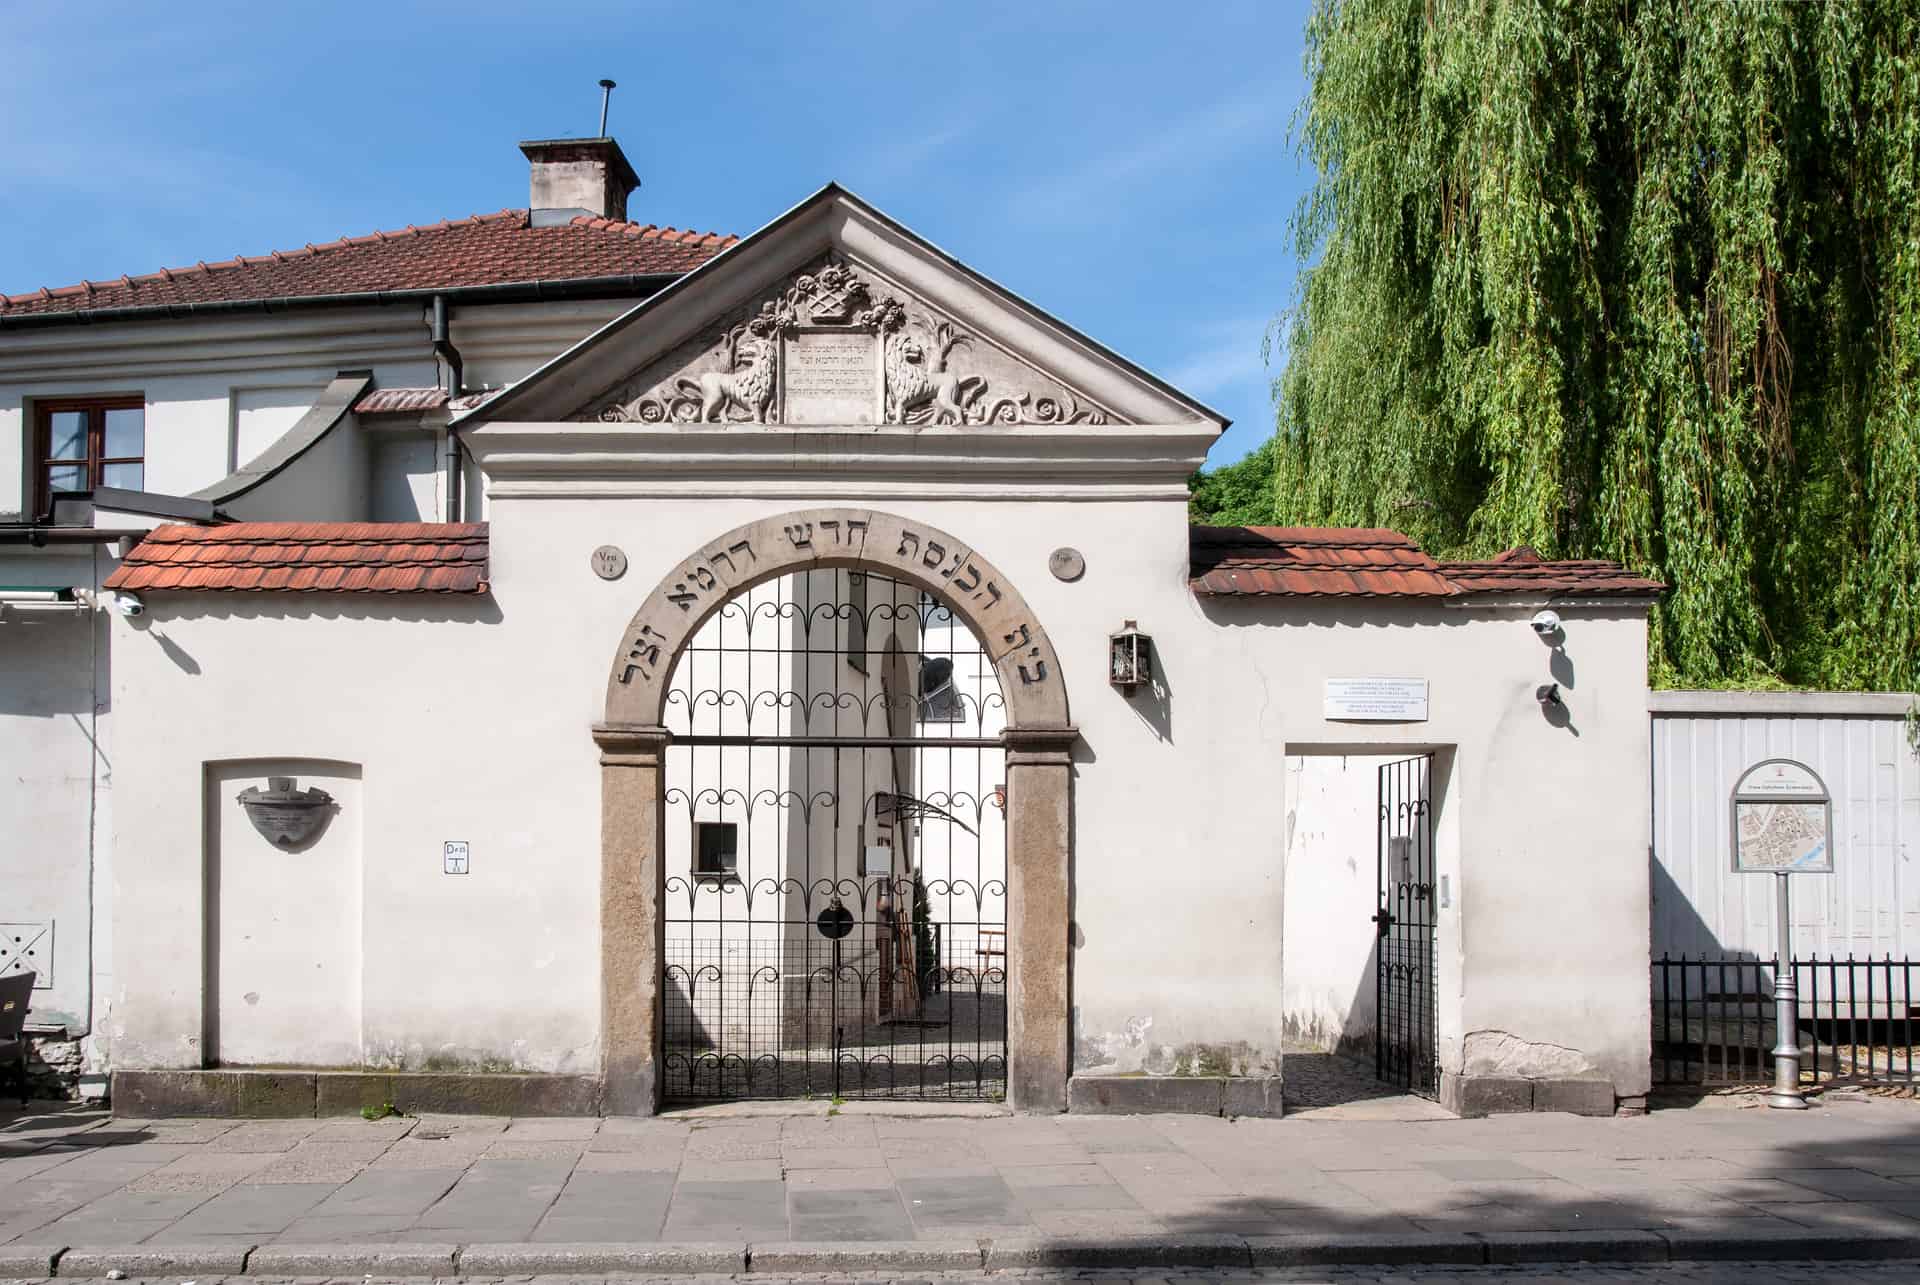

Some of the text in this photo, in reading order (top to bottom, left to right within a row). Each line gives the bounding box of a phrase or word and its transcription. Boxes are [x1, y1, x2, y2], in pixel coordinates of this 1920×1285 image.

[783, 519, 868, 550] חדש
[666, 541, 757, 611] דרמא
[897, 530, 1002, 609] הכנסת
[1003, 623, 1048, 685] בית
